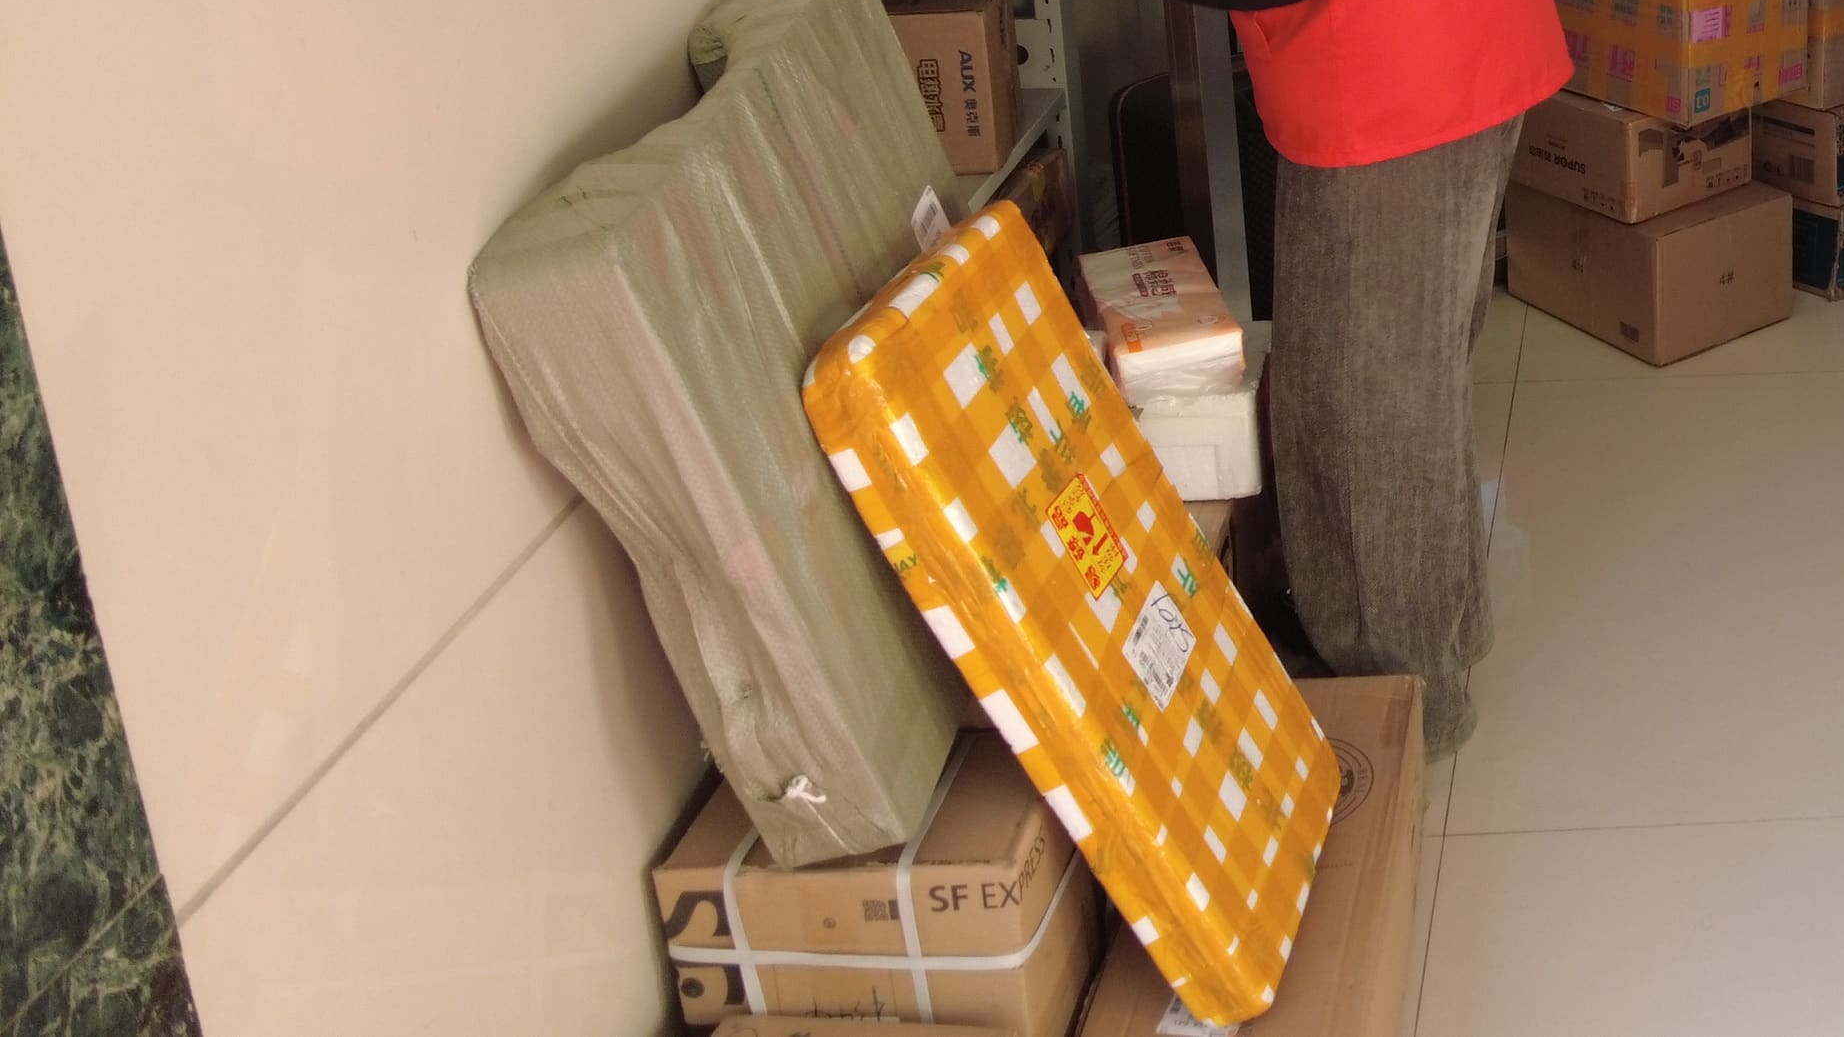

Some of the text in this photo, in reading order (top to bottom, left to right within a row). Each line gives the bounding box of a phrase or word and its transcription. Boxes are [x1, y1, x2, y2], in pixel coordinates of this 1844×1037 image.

[957, 49, 977, 93] AUX
[1552, 153, 1587, 175] SUPOR
[929, 826, 1047, 913] SF EXPRESS
